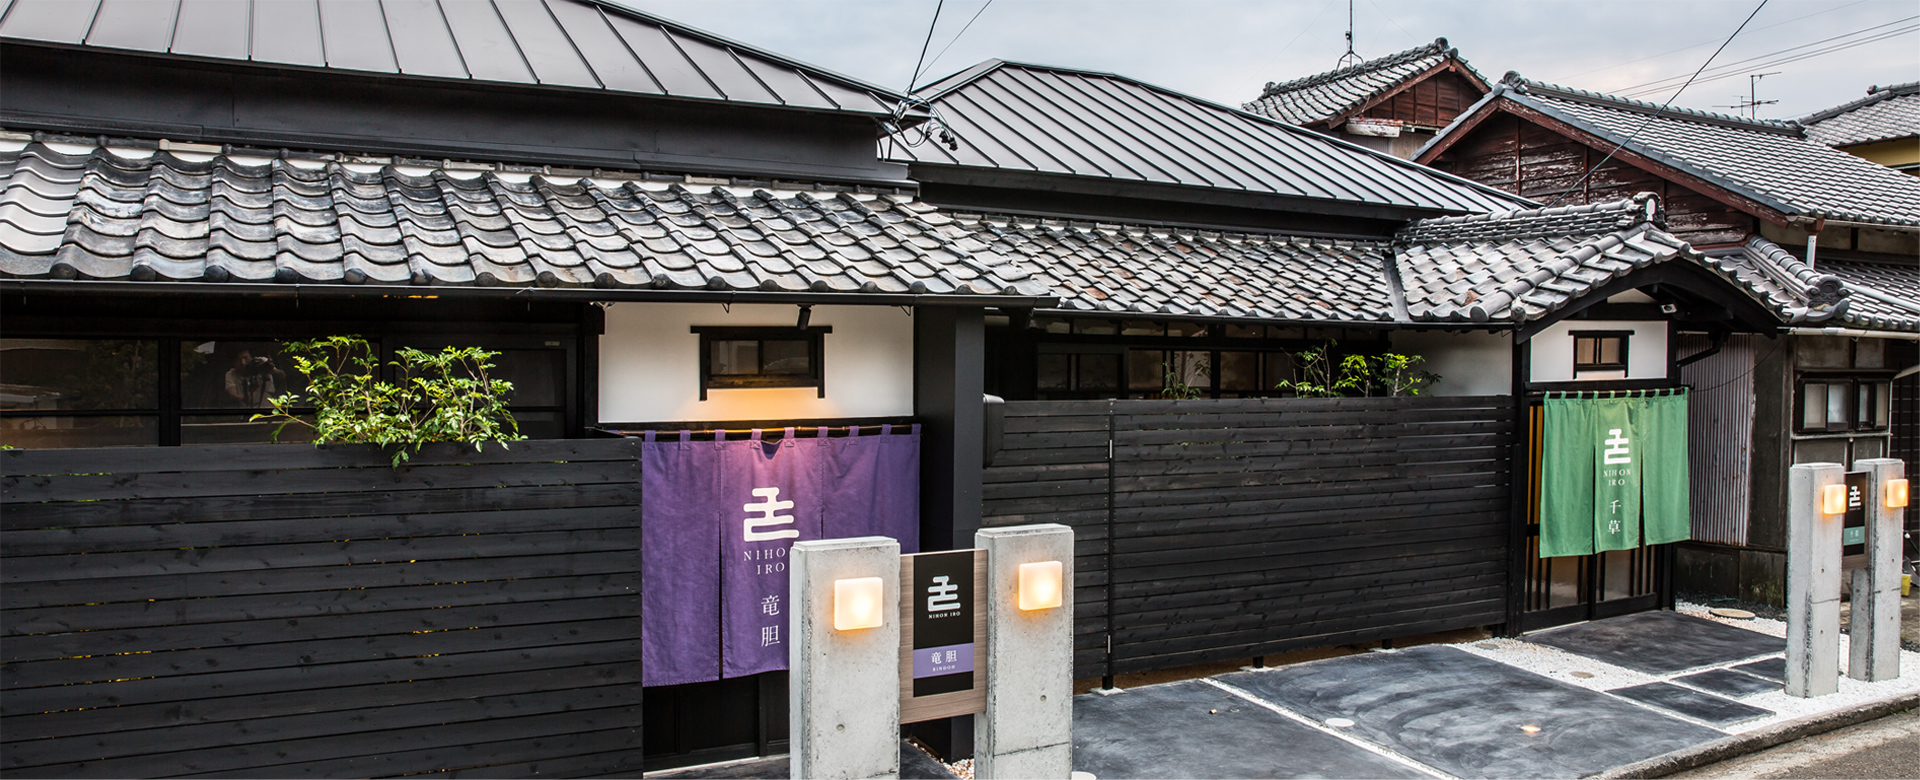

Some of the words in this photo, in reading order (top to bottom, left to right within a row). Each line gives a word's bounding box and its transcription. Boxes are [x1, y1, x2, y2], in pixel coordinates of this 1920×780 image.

[1603, 469, 1631, 477] NIHON
[1608, 499, 1621, 534] 千草
[744, 547, 786, 561] NIHO
[757, 562, 785, 575] IRO
[761, 594, 780, 647] 竜胆
[931, 650, 957, 664] 竜胆
